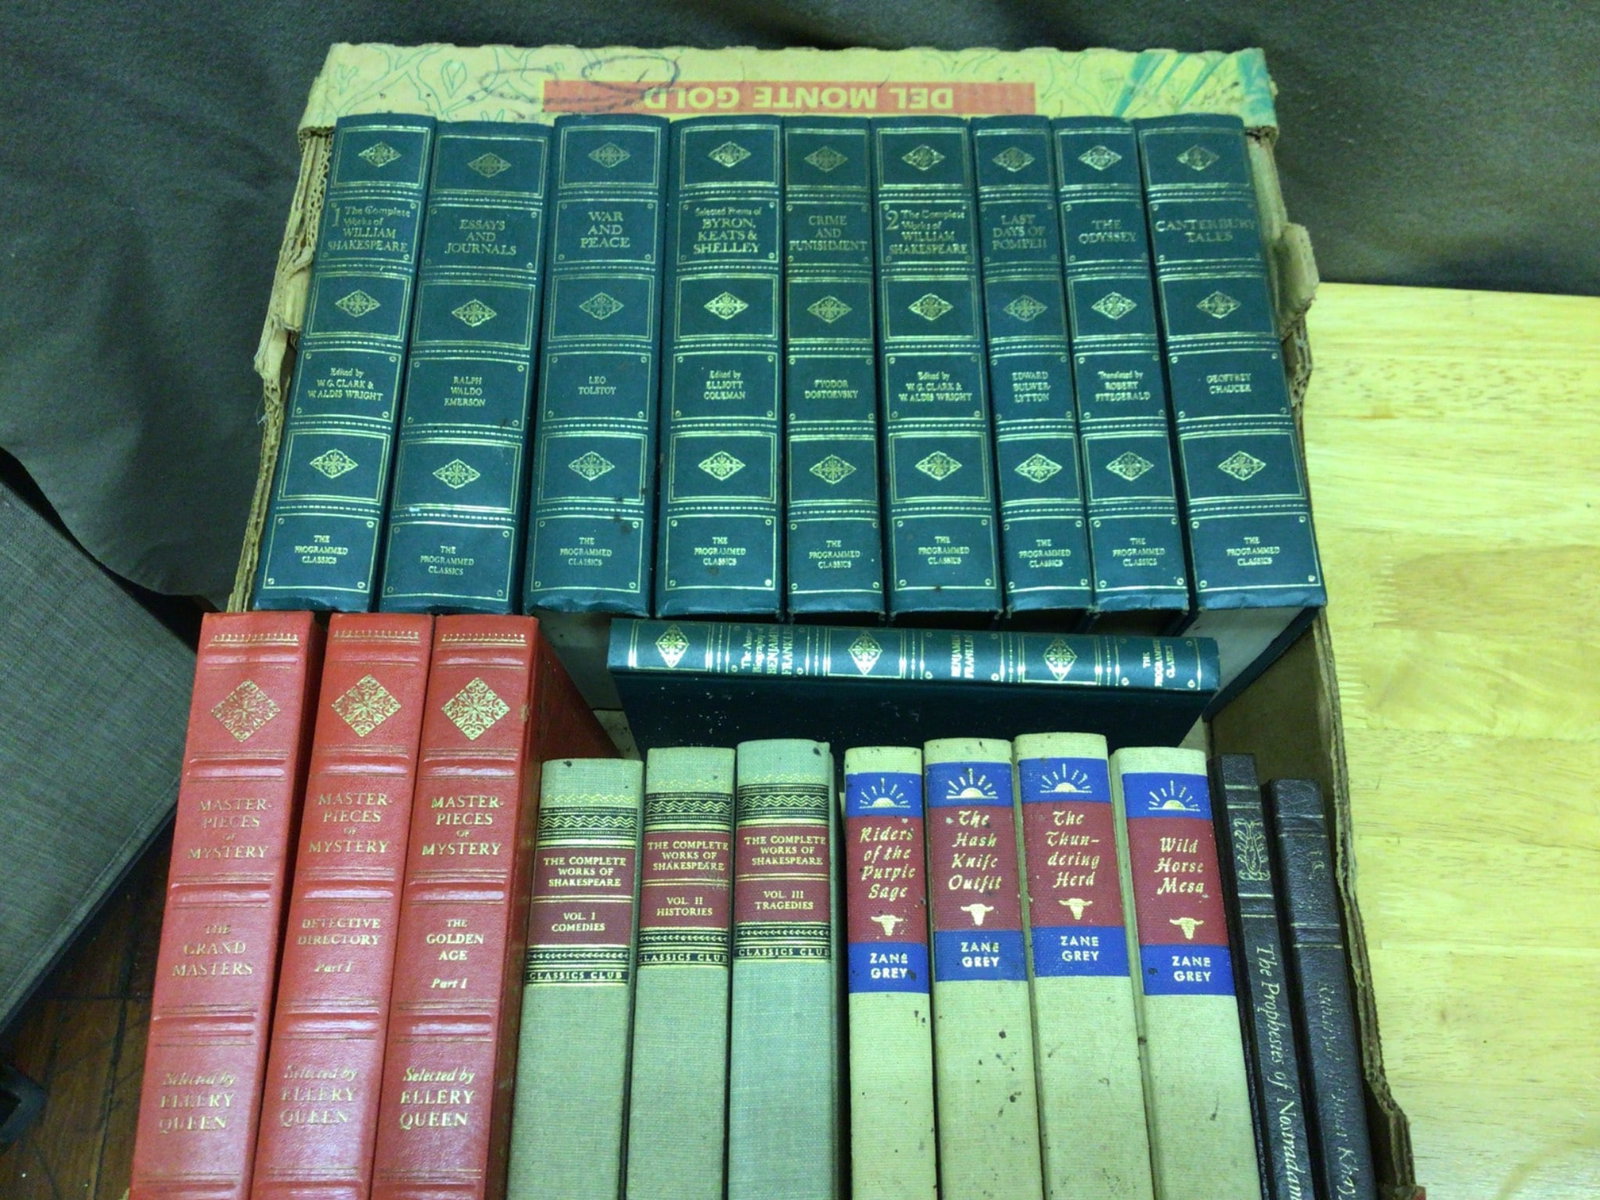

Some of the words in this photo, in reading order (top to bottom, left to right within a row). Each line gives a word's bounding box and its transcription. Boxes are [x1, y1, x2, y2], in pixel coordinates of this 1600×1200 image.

[645, 86, 740, 110] GOLD
[754, 86, 877, 110] MONTE
[890, 86, 954, 110] DEL
[588, 211, 624, 222] WAR
[808, 215, 848, 226] CRIME
[886, 210, 900, 231] 2
[1000, 214, 1036, 226] LAST
[458, 218, 506, 230] ESSAYS
[588, 224, 623, 236] AND
[1092, 219, 1122, 231] THE
[1155, 218, 1256, 232] CANTERBURY
[342, 227, 396, 239] WILLIAM
[466, 232, 496, 242] AND
[698, 230, 746, 242] KEATS
[747, 232, 758, 241] &
[814, 228, 842, 238] AND
[992, 226, 1025, 238] DAYS
[1078, 231, 1136, 244] ODYSSEY
[1184, 231, 1234, 243] TALES
[328, 240, 408, 253] SHAKESPEARE
[579, 236, 631, 248] PEACE
[693, 242, 761, 254] SHELLEY
[788, 240, 868, 252] PUNISHMENT
[444, 242, 516, 256] JOURNALS
[355, 368, 364, 378] by
[452, 376, 483, 386] RALPH
[588, 376, 606, 385] LEO
[706, 380, 744, 390] ELLIOTT
[345, 390, 384, 402] WRIGHT
[450, 386, 483, 396] WALDO
[578, 386, 616, 396] TOLSTOY
[704, 390, 746, 400] COLEMAN
[444, 397, 486, 408] EMERSON
[314, 535, 330, 544] THE
[578, 537, 595, 546] THE
[712, 536, 728, 545] THE
[826, 540, 842, 548] THE
[934, 536, 951, 544] THE
[1036, 538, 1052, 547] THE
[1130, 537, 1146, 546] THE
[1244, 536, 1260, 545] THE
[294, 546, 348, 556] PROGRAMMED
[440, 545, 456, 554] THE
[560, 548, 612, 558] PROGRAMMED
[694, 547, 746, 556] PROGRAMMED
[808, 550, 861, 560] PROGRAMMED
[1112, 547, 1166, 558] PROGRAMMED
[1226, 546, 1280, 556] PROGRAMMED
[302, 556, 338, 565] CLASSICS
[420, 555, 474, 566] PROGRAMMED
[568, 558, 603, 567] CLASSICS
[702, 557, 737, 566] CLASSICS
[818, 560, 852, 569] CLASSICS
[1122, 558, 1158, 567] CLASSICS
[1236, 556, 1272, 566] CLASSICS
[428, 566, 464, 576] CLASSICS
[432, 796, 504, 809] MASTER-
[202, 814, 260, 828] PIECES
[322, 810, 382, 824] PIECES
[436, 812, 494, 826] PIECES
[958, 809, 990, 828] The
[1052, 808, 1084, 826] The
[744, 836, 768, 846] THE
[770, 834, 826, 846] COMPLETE
[859, 826, 914, 844] Riders
[950, 831, 996, 848] Hash
[1045, 831, 1100, 848] Thun-
[308, 840, 390, 854] MYSTERY
[422, 842, 502, 856] MYSTERY
[647, 841, 670, 851] THE
[672, 840, 729, 852] COMPLETE
[760, 845, 797, 856] WORKS
[800, 845, 815, 855] OF
[1159, 836, 1198, 854] Wild
[188, 844, 268, 860] MYSTERY
[661, 851, 699, 861] WORKS
[702, 851, 718, 860] OF
[863, 846, 882, 862] of
[884, 844, 912, 860] the
[543, 856, 566, 866] THE
[568, 856, 627, 867] COMPLETE
[652, 860, 725, 872] SHAKESPEARE
[752, 855, 824, 866] SHAKESPEARE
[950, 852, 998, 871] Knife
[1046, 851, 1100, 870] dering
[1154, 856, 1204, 876] Horse
[558, 867, 596, 877] WORKS
[599, 867, 614, 877] OF
[862, 865, 916, 884] Purple
[548, 878, 622, 888] SHAKESPEARE
[948, 872, 1002, 893] Outfit
[1052, 870, 1096, 888] Herd
[1156, 876, 1205, 895] Mesa
[763, 890, 787, 900] VOL.
[790, 890, 804, 900] III
[868, 884, 908, 903] Sage
[666, 896, 690, 906] VOL.
[694, 896, 703, 906] II
[754, 900, 814, 912] TRAGEDIES
[563, 912, 587, 922] VOL.
[656, 906, 713, 918] HISTORIES
[302, 918, 381, 930] DETECTIVE
[446, 918, 468, 928] THE
[551, 922, 606, 932] COMEDIES
[204, 924, 231, 935] THE
[298, 934, 380, 946] DIRECTORY
[426, 932, 484, 946] GOLDEN
[1060, 935, 1100, 948] ZANE
[184, 941, 247, 956] GRAND
[738, 948, 794, 958] CLASSICS
[960, 941, 1000, 954] ZANE
[438, 950, 468, 962] AGE
[638, 952, 691, 964] CLASSICS
[869, 952, 908, 965] ZANE
[962, 955, 1000, 968] GREY
[1062, 949, 1100, 962] GREY
[1172, 955, 1212, 968] ZANE
[1256, 942, 1278, 978] The
[172, 962, 254, 977] MASTERS
[314, 962, 342, 973] Part
[870, 966, 908, 980] GREY
[529, 970, 585, 981] CLASSICS
[590, 970, 623, 980] CLUB
[1173, 969, 1212, 983] GREY
[430, 978, 458, 990] Part
[1256, 980, 1286, 1066] Prophesies
[284, 1065, 338, 1080] Selected
[340, 1066, 358, 1084] by
[402, 1067, 458, 1082] Selected
[460, 1068, 475, 1086] by
[162, 1072, 216, 1086] Selected
[216, 1072, 236, 1090] by
[1266, 1072, 1296, 1094] of
[280, 1087, 357, 1102] ELLERY
[400, 1089, 476, 1105] ELLERY
[160, 1093, 235, 1109] ELLERY
[160, 1116, 227, 1134] QUEEN
[280, 1110, 350, 1128] QUEEN
[399, 1112, 469, 1130] QUEEN
